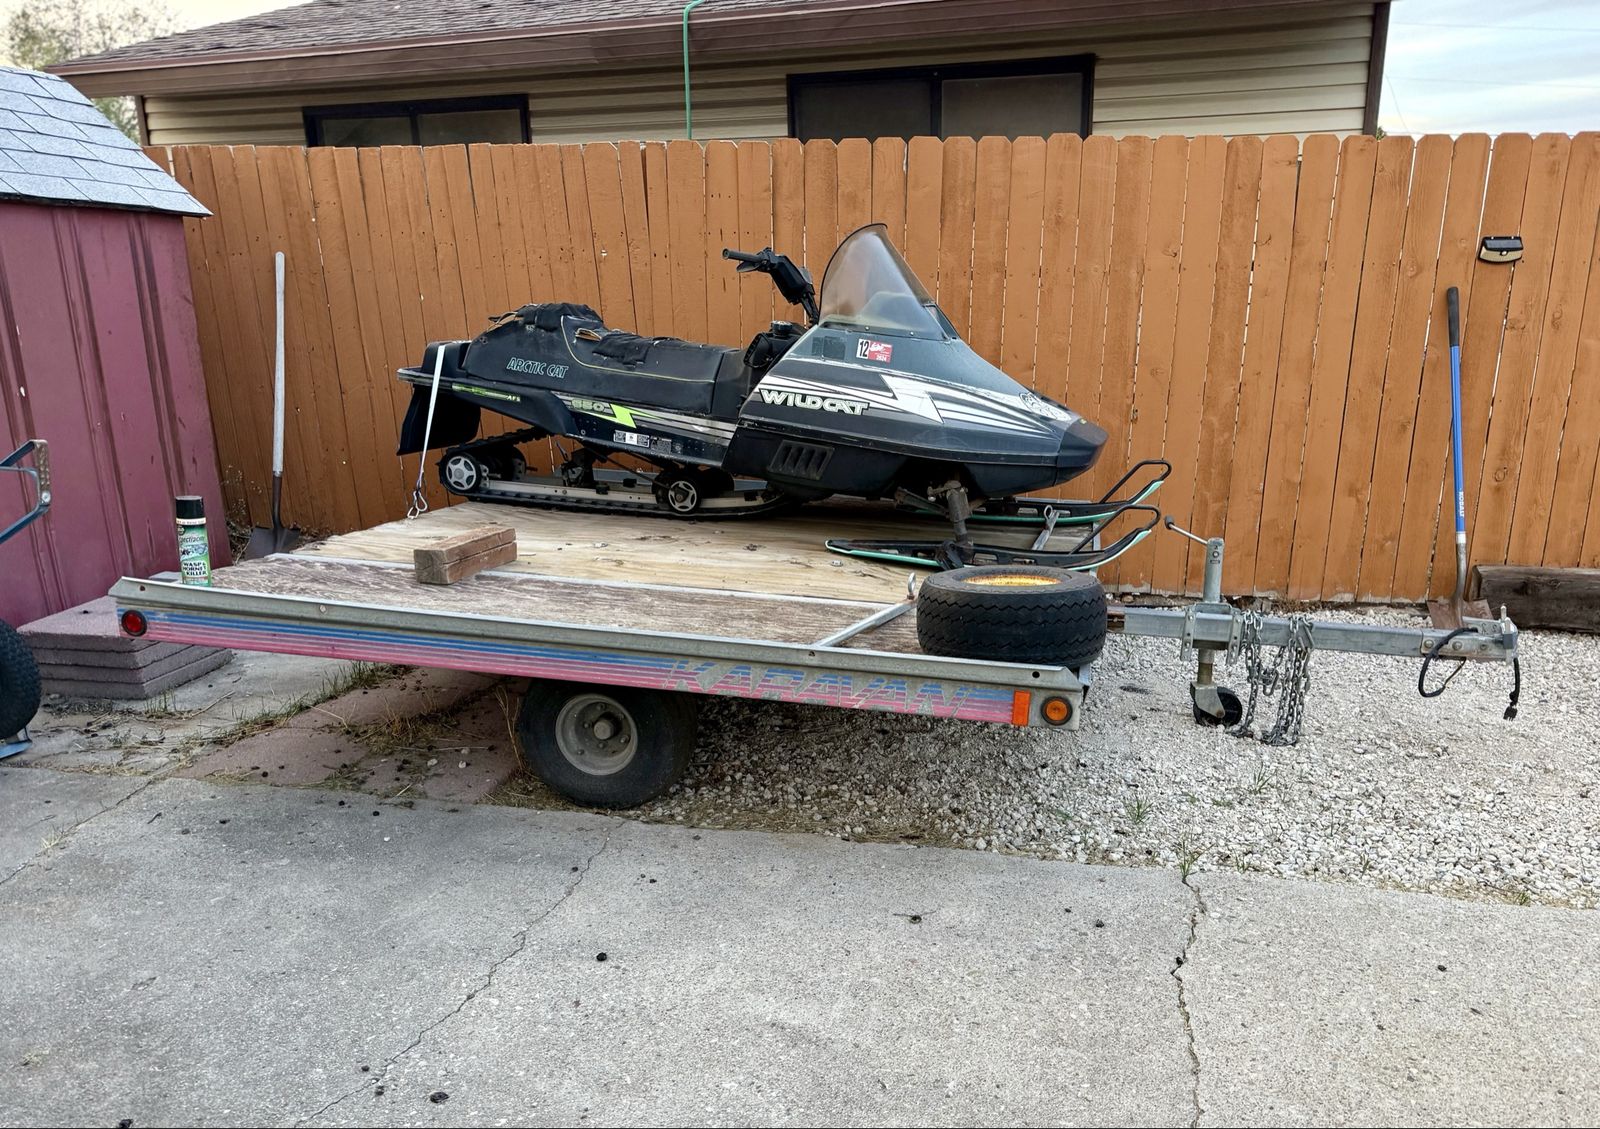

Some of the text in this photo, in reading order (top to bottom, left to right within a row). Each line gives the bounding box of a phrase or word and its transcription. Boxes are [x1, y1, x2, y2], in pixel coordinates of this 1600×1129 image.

[859, 340, 869, 358] 12
[506, 357, 569, 379] ARCTIC CAT
[760, 389, 869, 415] WILDCAT
